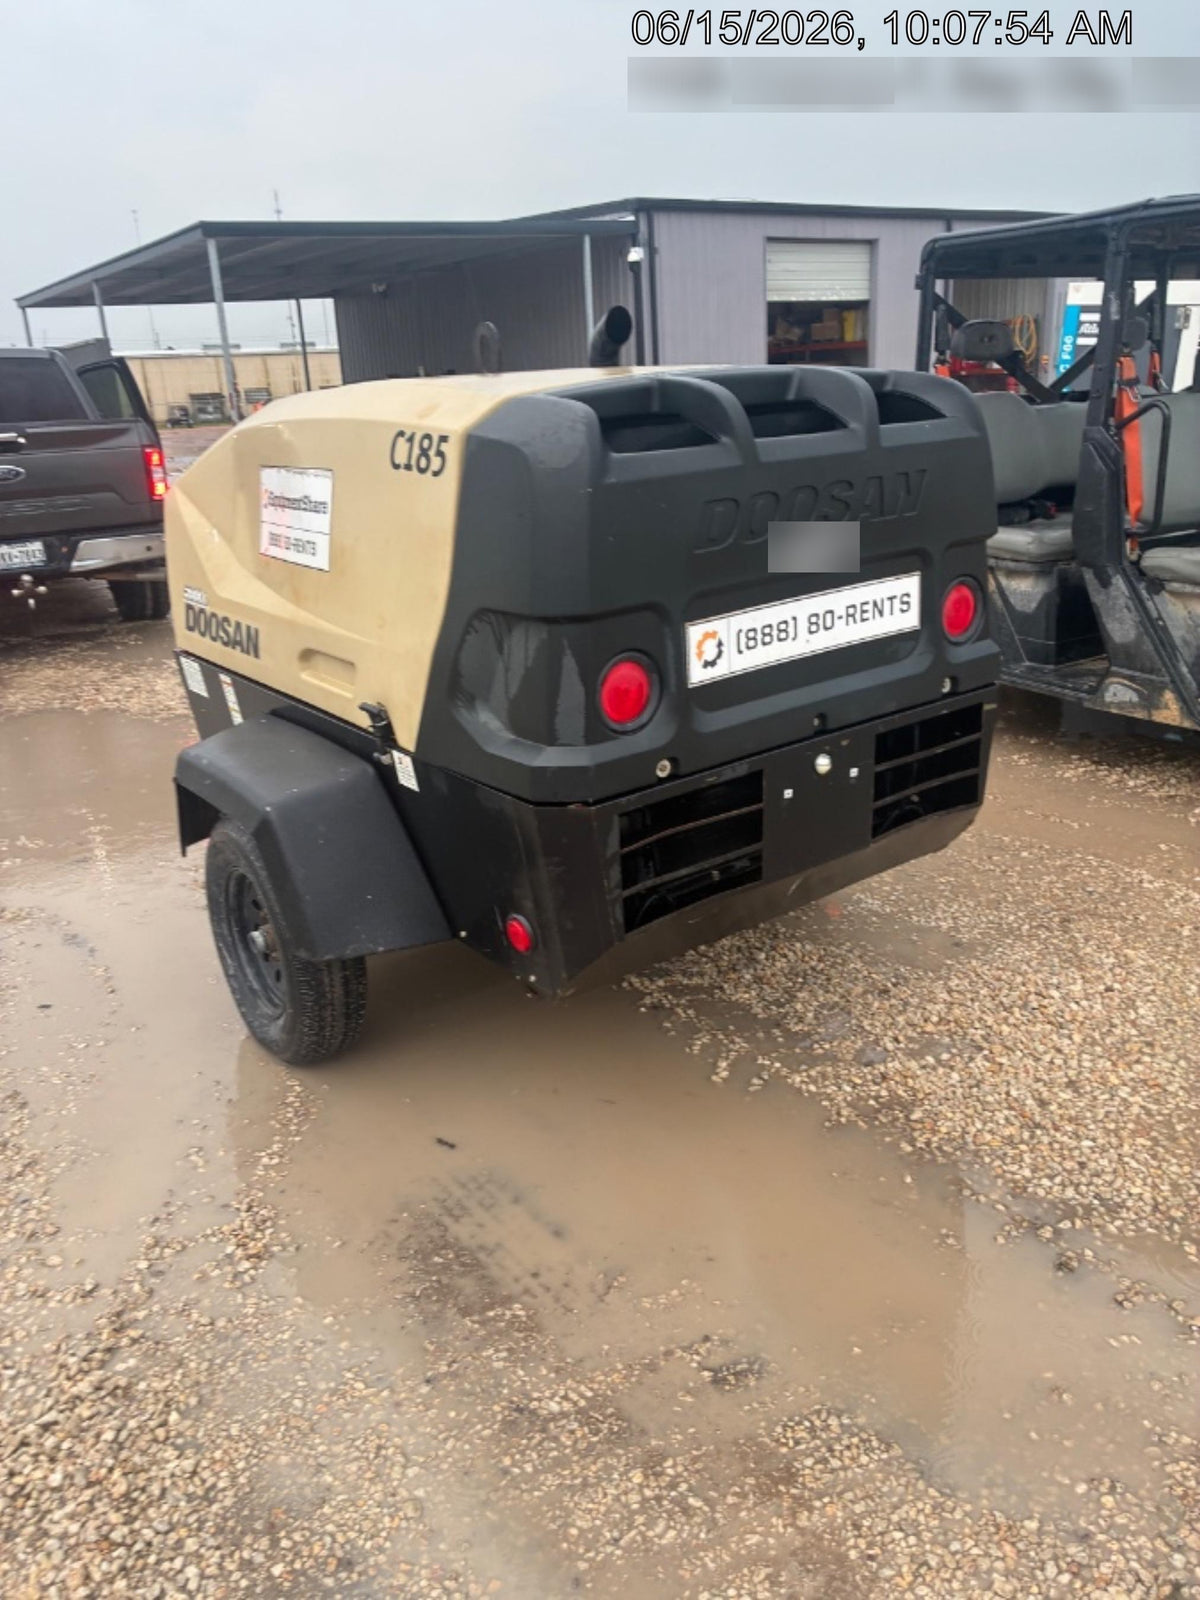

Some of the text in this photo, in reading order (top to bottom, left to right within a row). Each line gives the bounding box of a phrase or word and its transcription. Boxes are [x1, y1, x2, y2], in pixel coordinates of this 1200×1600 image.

[389, 429, 449, 477] C185
[695, 468, 928, 554] DOOSAN
[185, 603, 260, 659] DOOSAN
[736, 592, 912, 654] (888) 80-RENTS
